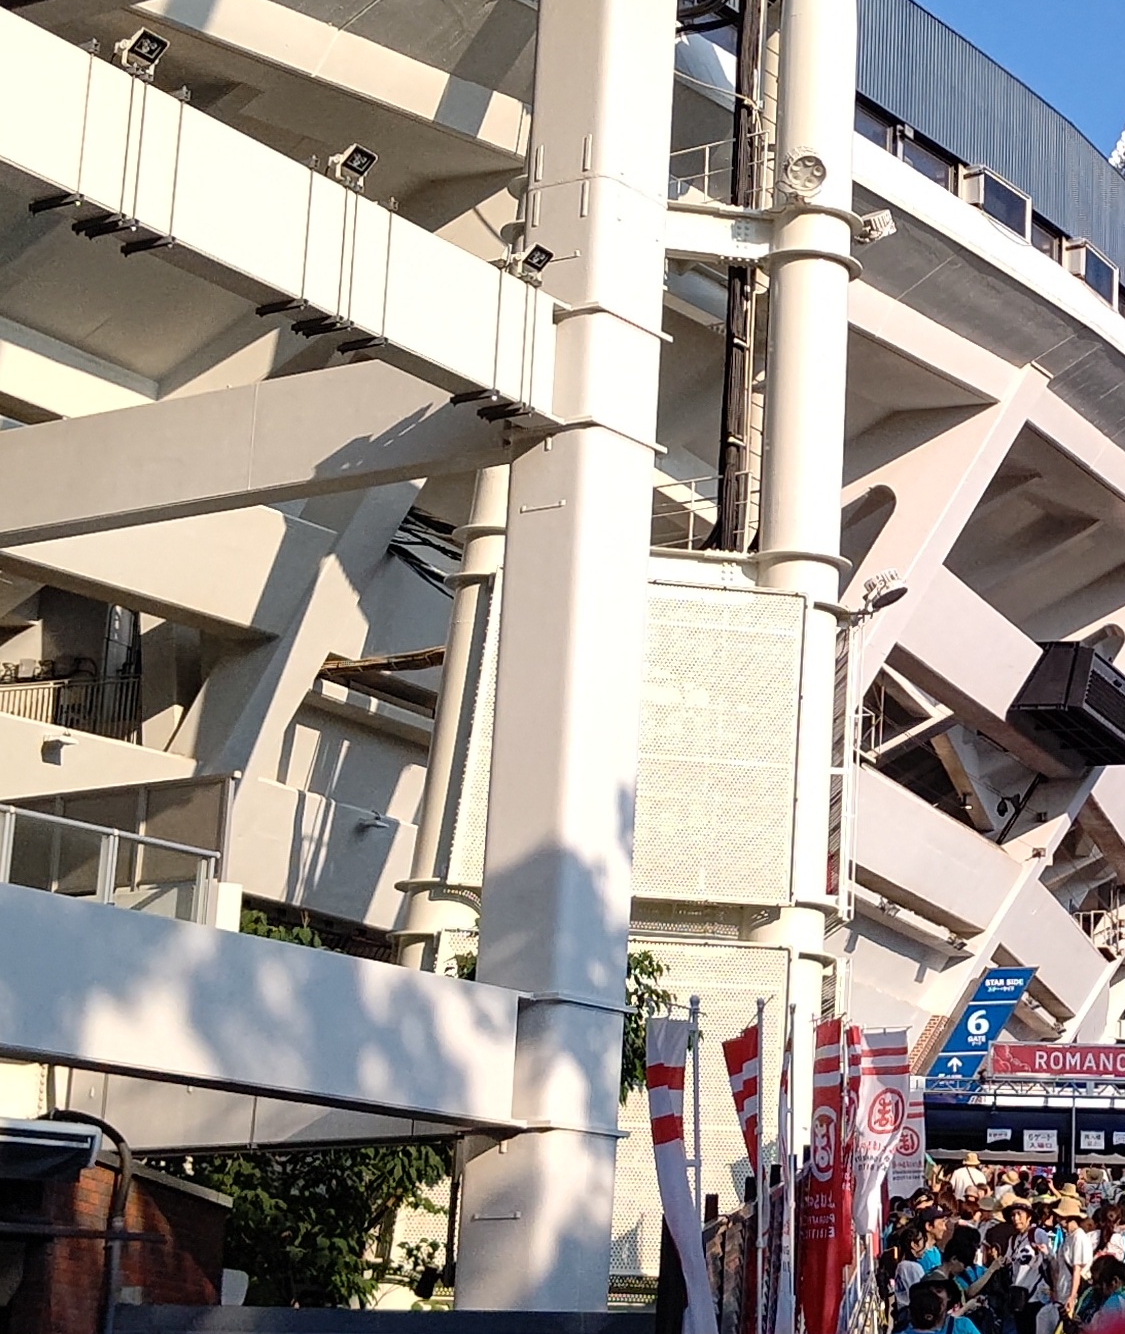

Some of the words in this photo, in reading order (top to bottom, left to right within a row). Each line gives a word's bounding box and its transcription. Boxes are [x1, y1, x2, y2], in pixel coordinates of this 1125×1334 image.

[985, 978, 1004, 987] STAR
[1006, 978, 1024, 986] SIDE
[967, 1009, 989, 1035] 6
[967, 1035, 986, 1043] GATE
